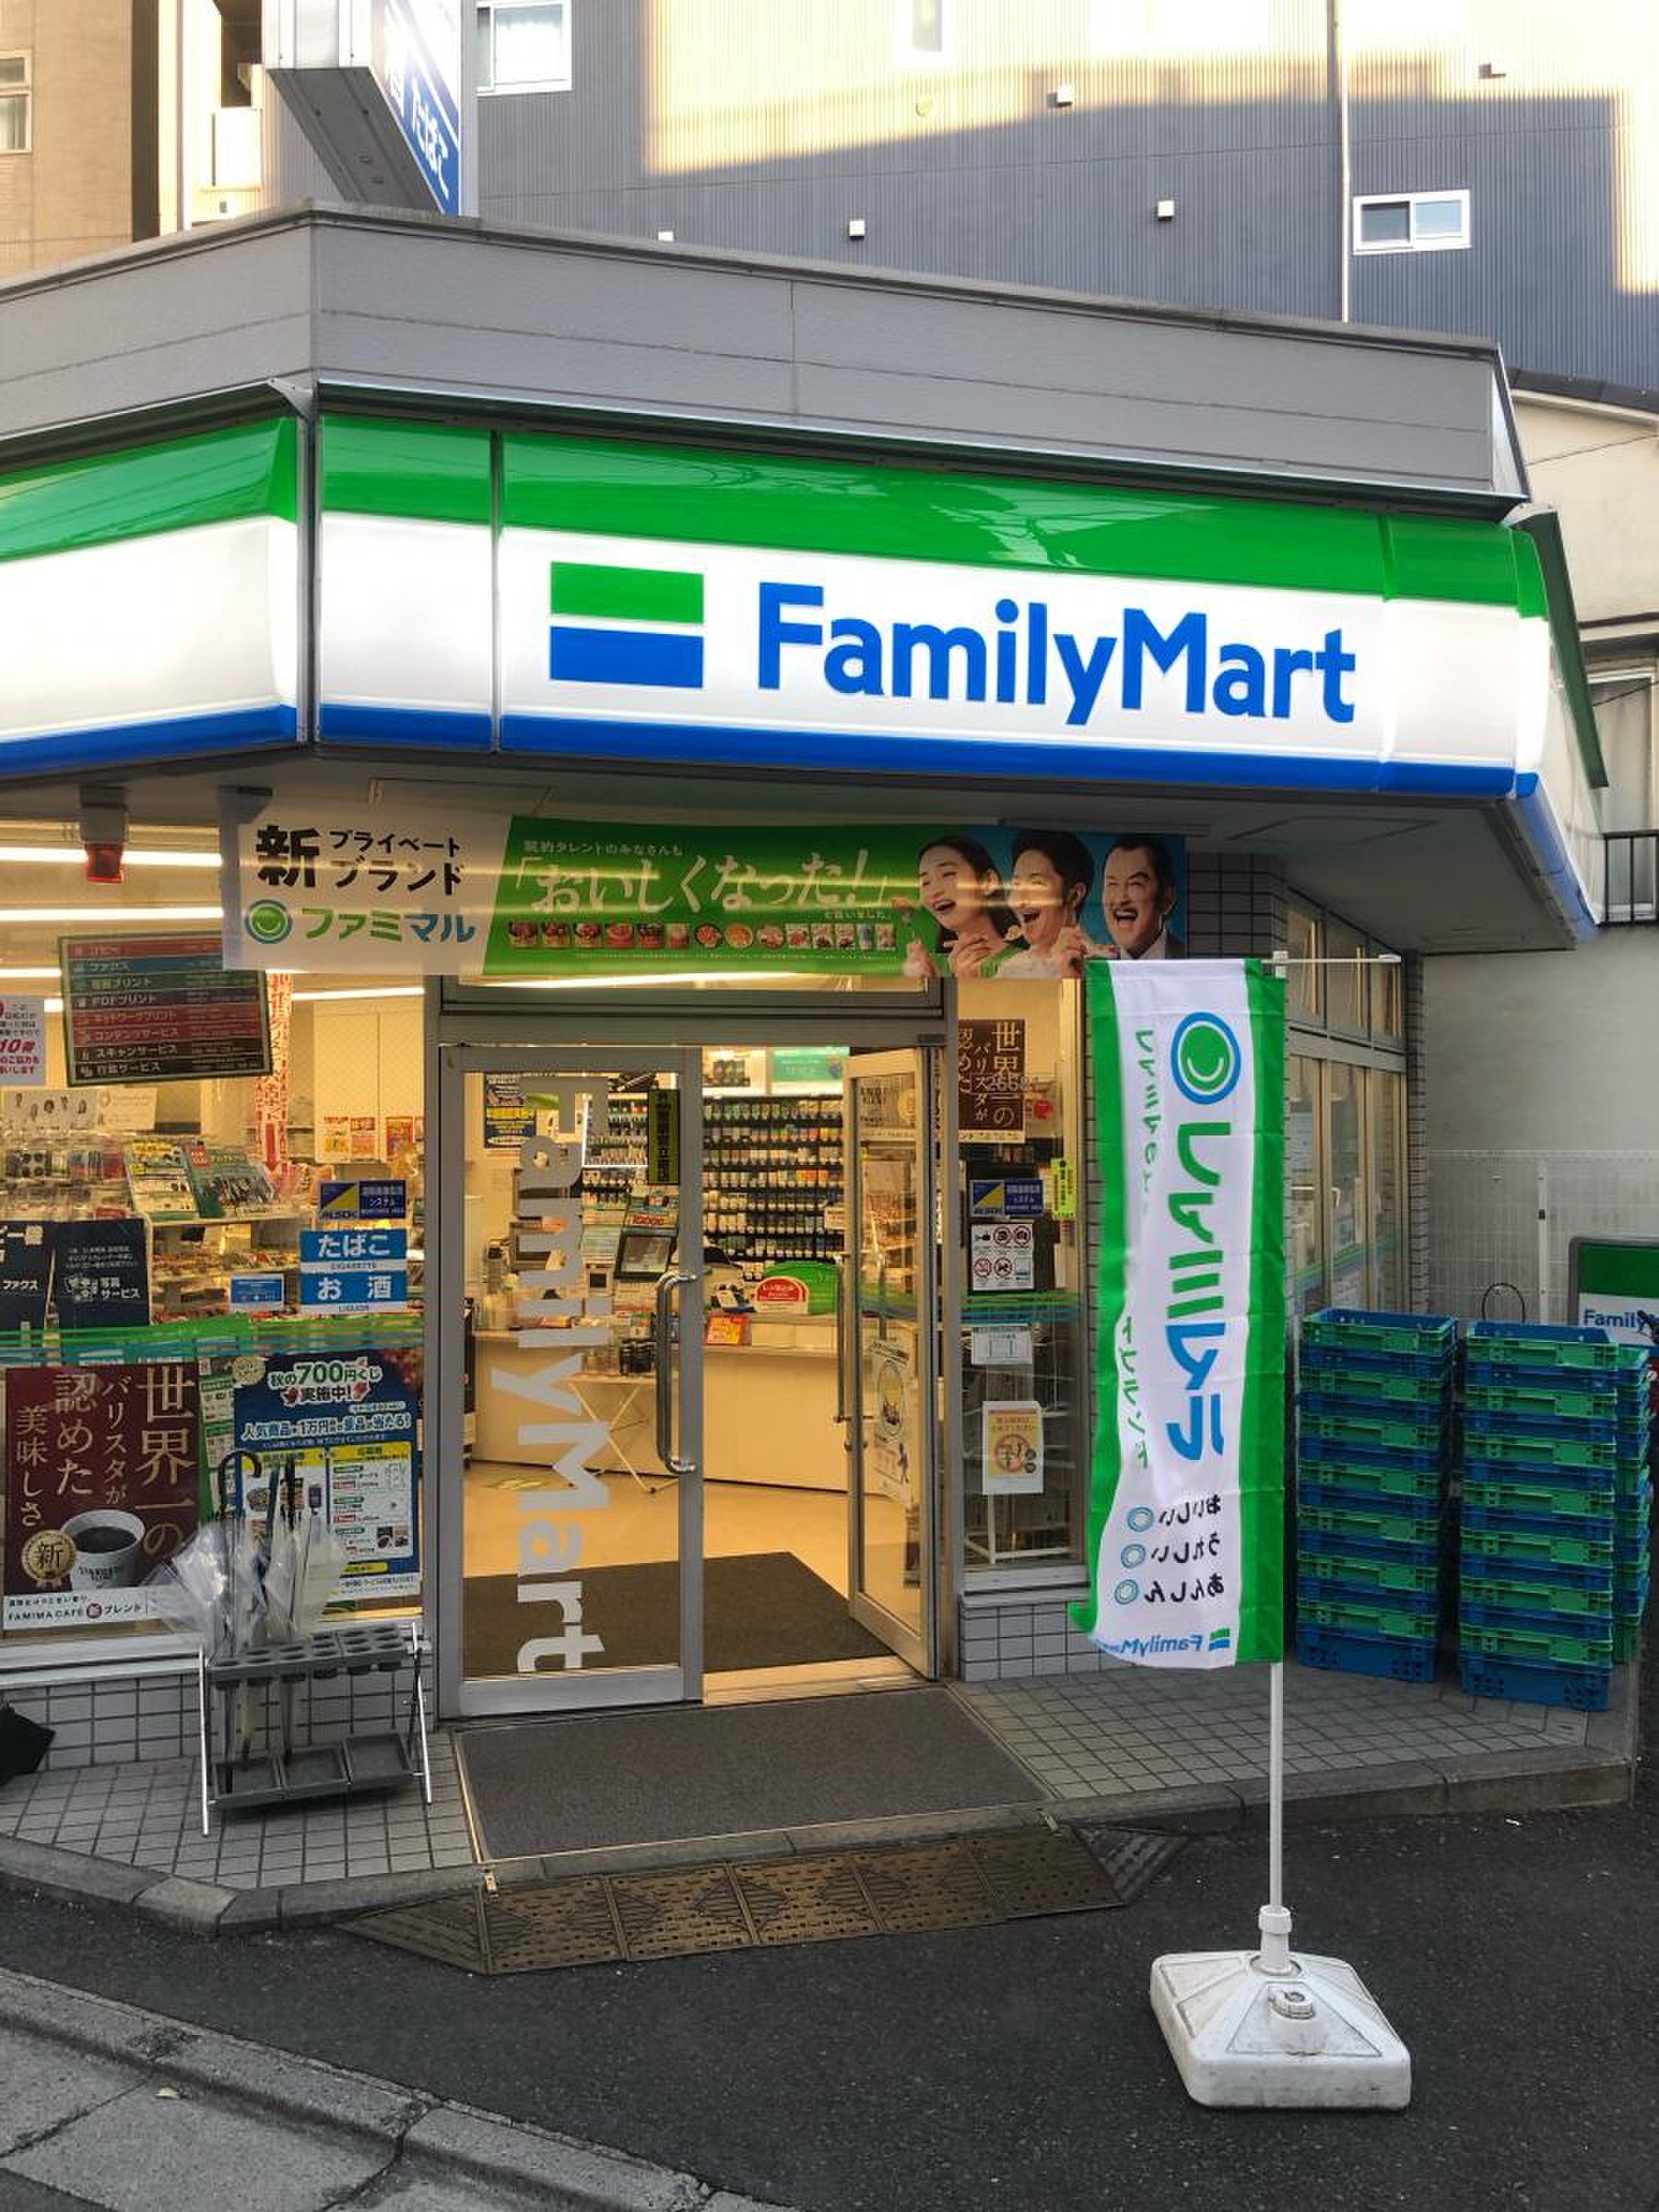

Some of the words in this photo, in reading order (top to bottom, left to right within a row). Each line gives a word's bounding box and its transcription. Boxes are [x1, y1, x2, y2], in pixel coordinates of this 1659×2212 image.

[759, 582, 1356, 725] FamilyMart
[255, 825, 320, 888] 新
[330, 855, 465, 896] ブランド
[300, 908, 476, 943] ファミマル
[317, 1233, 390, 1258] たばこ
[3, 1279, 39, 1290] ファクス
[101, 1288, 140, 1299] サービス
[490, 1076, 610, 1673] FamilyMart
[53, 1373, 98, 1495] 認めた
[102, 1375, 132, 1506] バリスタが
[135, 1366, 196, 1555] 世界一の
[16, 1406, 48, 1526] 美味しさ
[35, 1542, 63, 1571] 新
